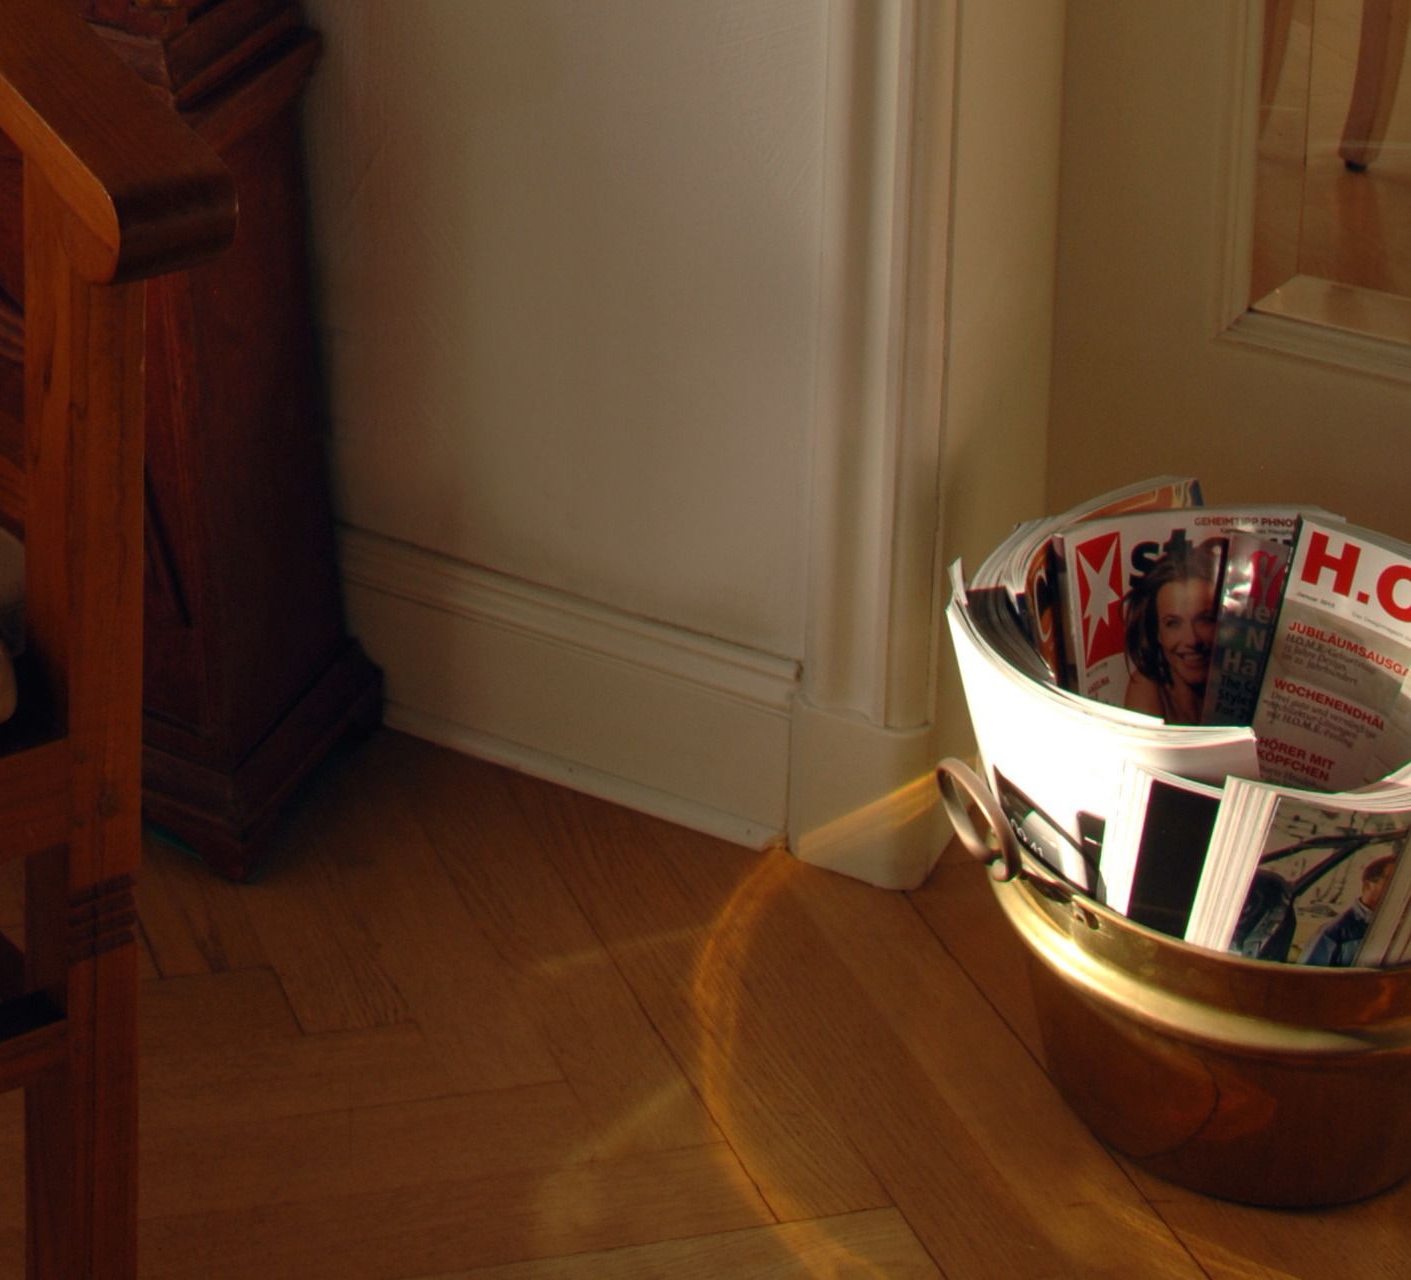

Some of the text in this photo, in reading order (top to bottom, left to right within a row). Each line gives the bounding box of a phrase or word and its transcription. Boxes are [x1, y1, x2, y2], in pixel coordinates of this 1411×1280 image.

[1257, 748, 1330, 783] KÖPFCHEN
[1258, 736, 1336, 771] HÖRER MIT
